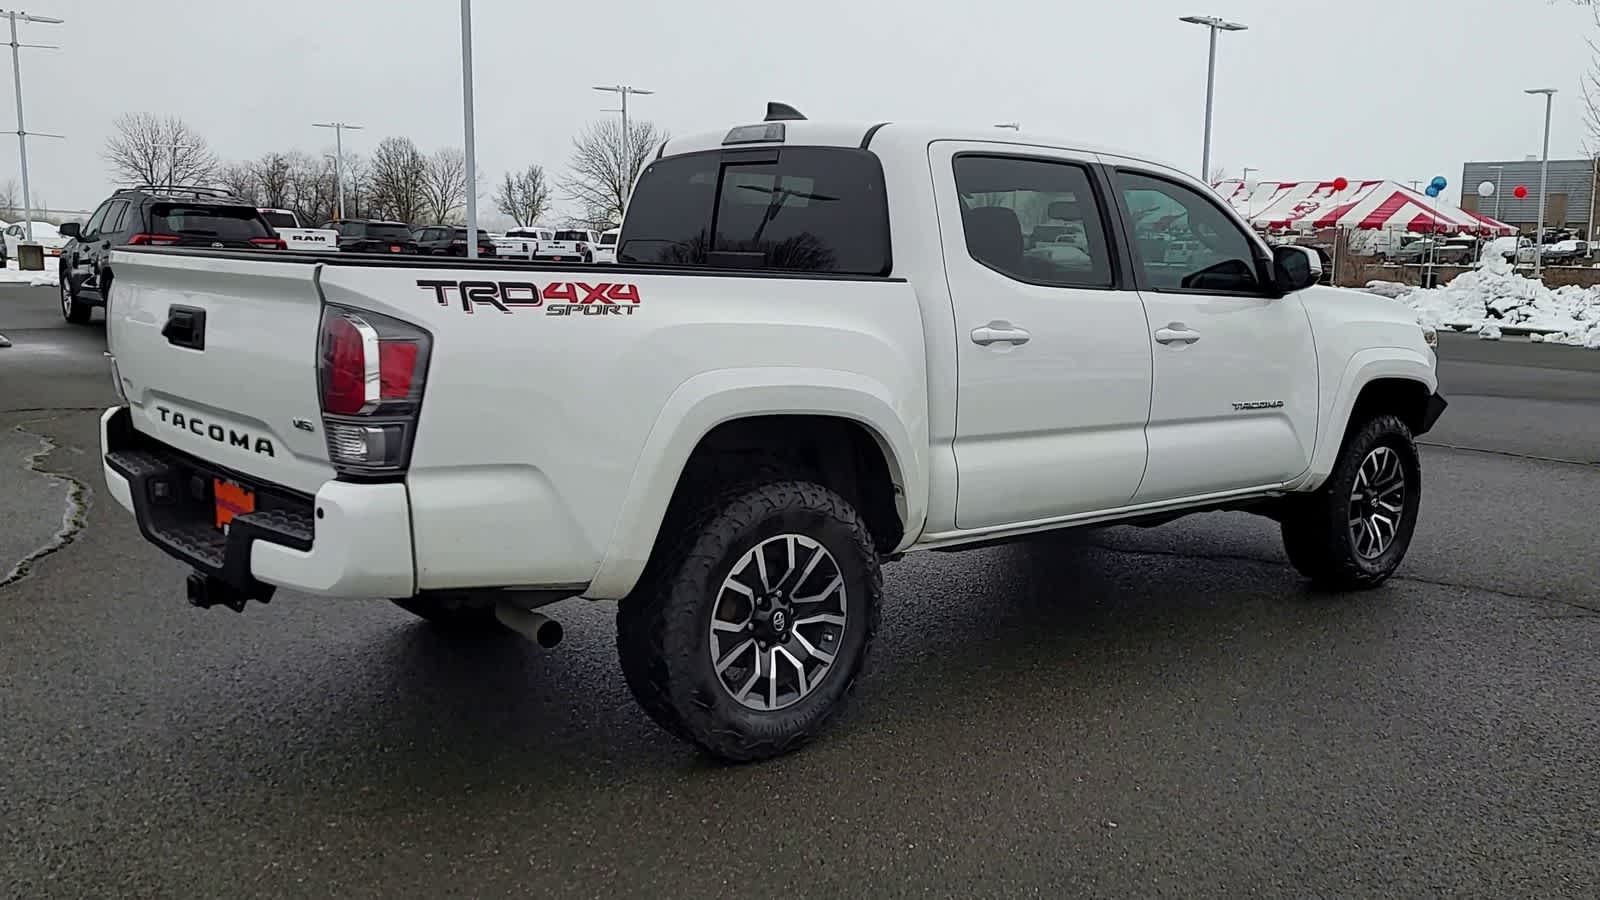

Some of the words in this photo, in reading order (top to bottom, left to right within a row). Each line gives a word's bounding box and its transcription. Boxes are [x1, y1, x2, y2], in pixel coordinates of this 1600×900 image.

[546, 303, 640, 316] SPORT
[1231, 400, 1285, 410] TACOMA
[156, 405, 275, 458] TACOMA
[292, 417, 315, 433] V6
